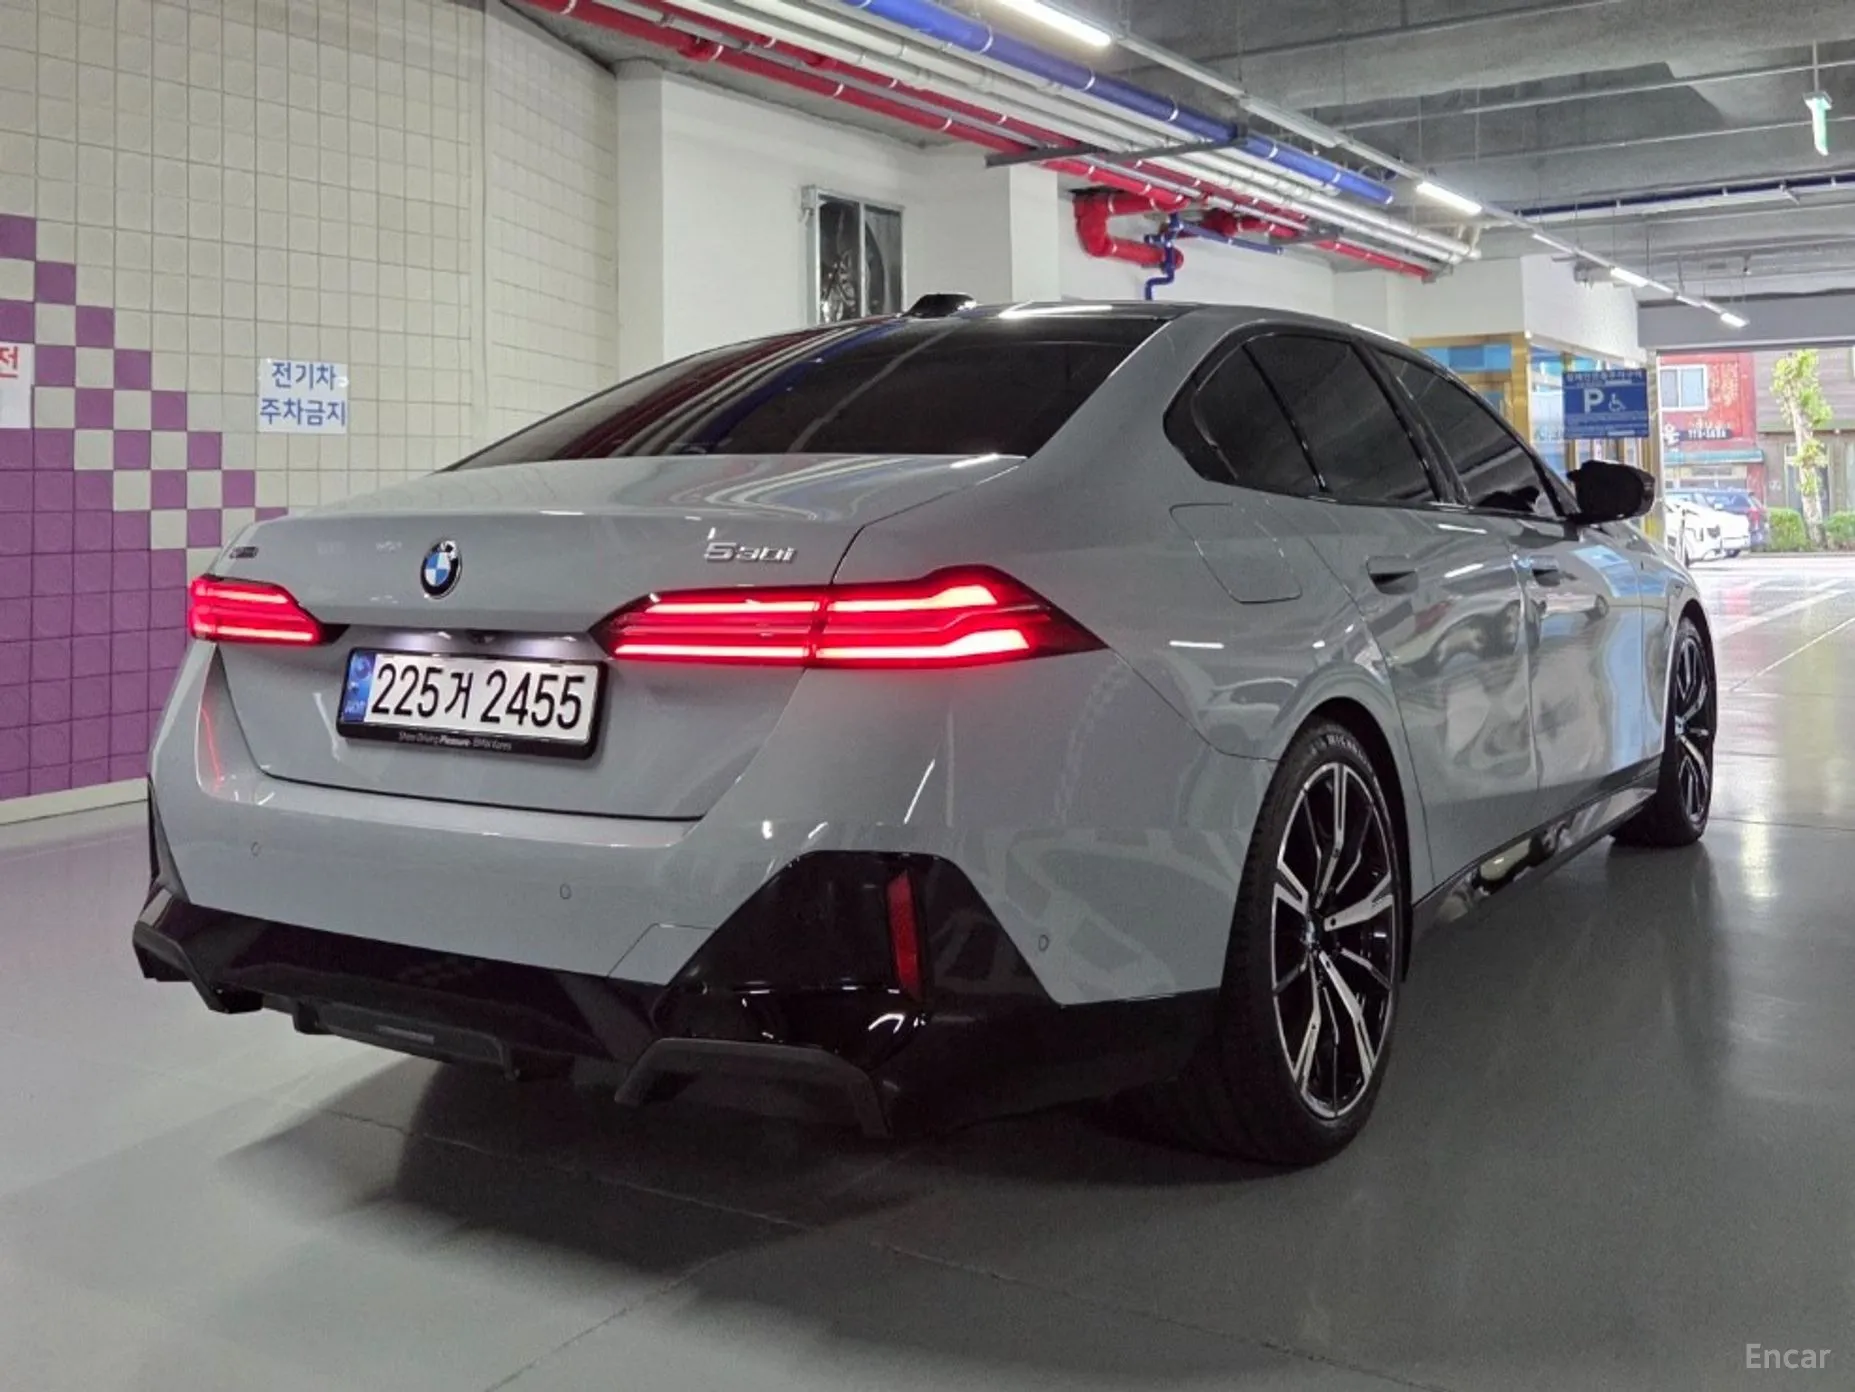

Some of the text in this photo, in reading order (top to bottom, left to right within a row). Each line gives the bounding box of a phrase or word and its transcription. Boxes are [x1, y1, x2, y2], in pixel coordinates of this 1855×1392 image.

[272, 362, 336, 391] 전기차
[260, 398, 345, 427] 주차금지
[1584, 388, 1604, 413] P
[704, 541, 796, 562] 530i
